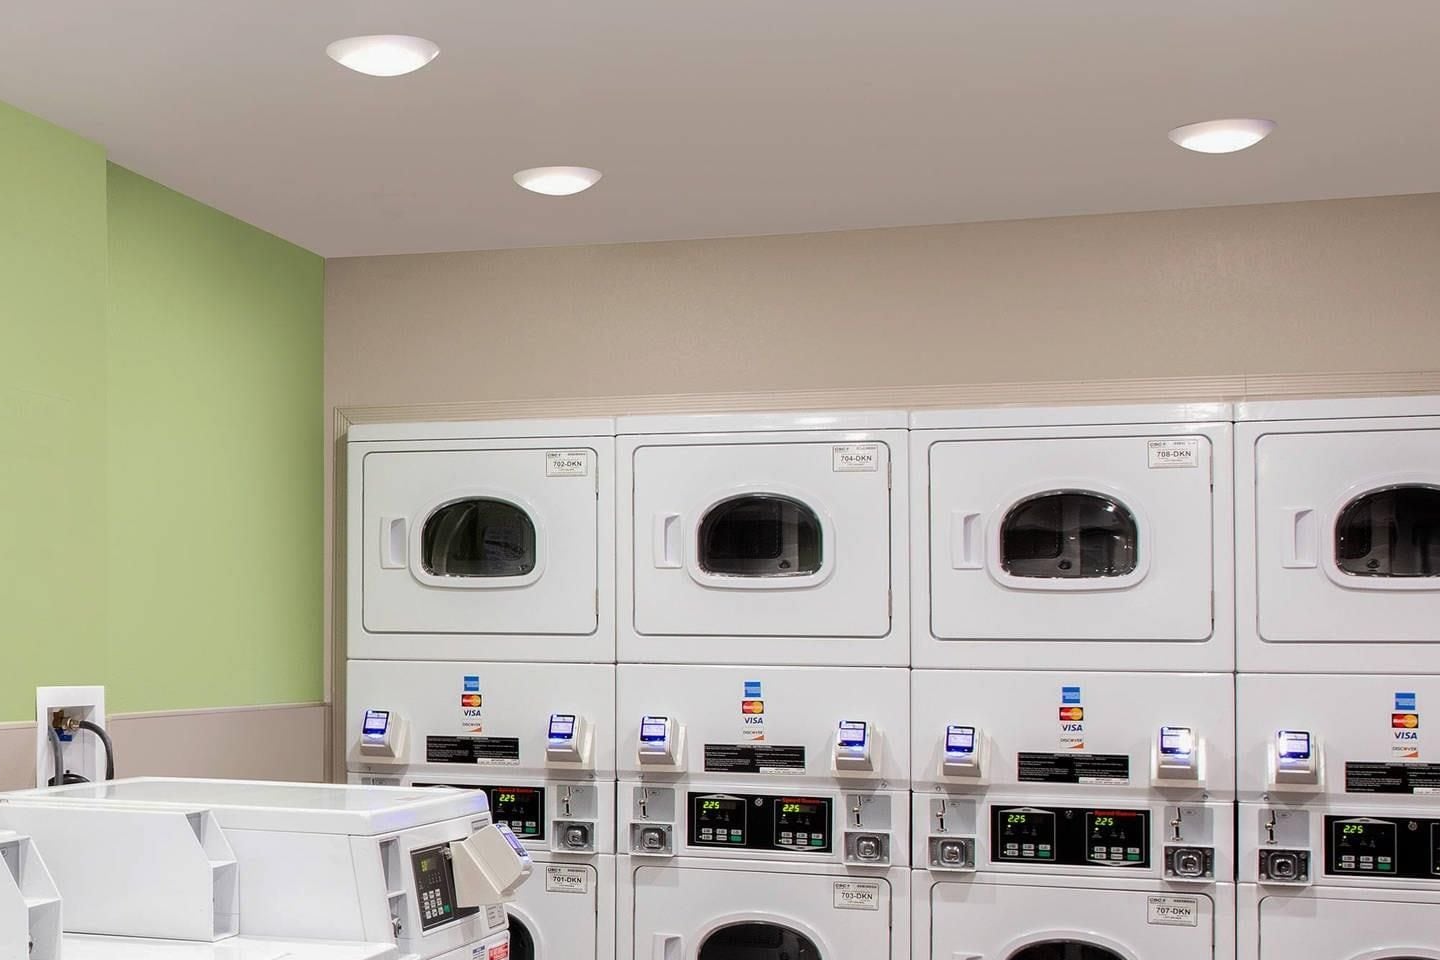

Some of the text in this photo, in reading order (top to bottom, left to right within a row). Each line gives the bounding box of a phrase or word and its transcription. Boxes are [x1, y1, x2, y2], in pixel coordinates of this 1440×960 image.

[464, 709, 481, 717] VISA
[1062, 724, 1083, 732] VISA
[1395, 731, 1418, 740] VISA
